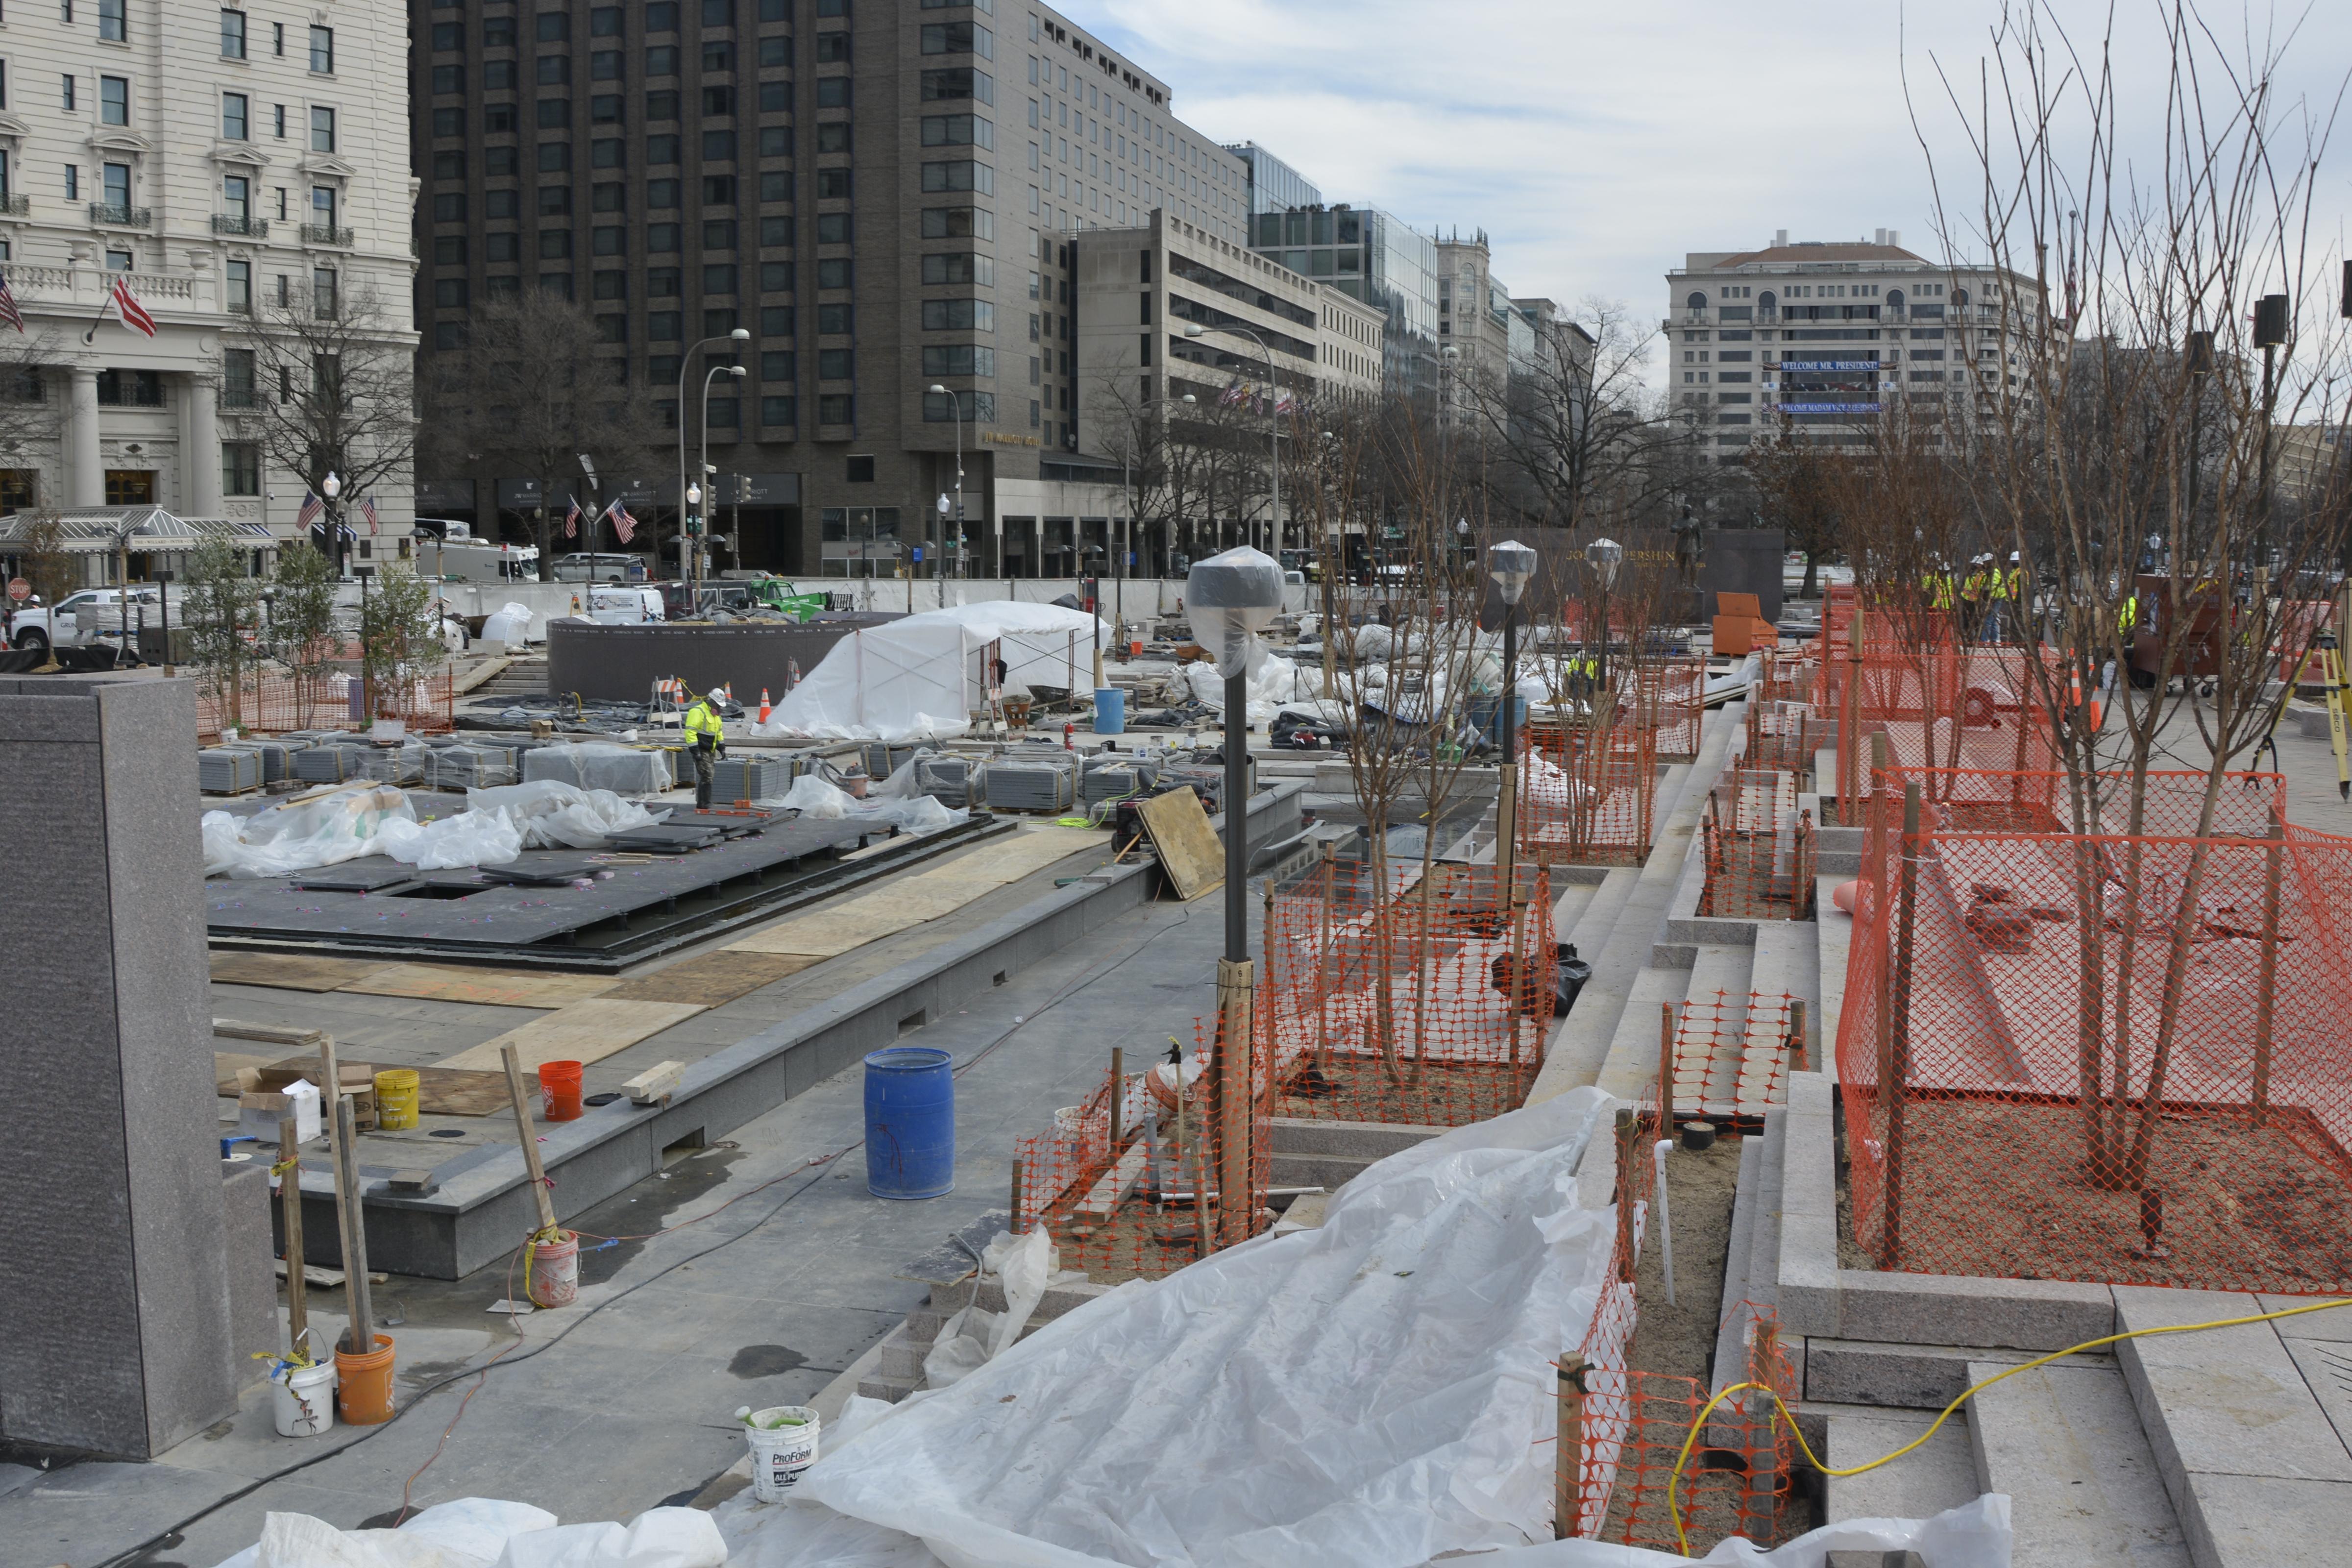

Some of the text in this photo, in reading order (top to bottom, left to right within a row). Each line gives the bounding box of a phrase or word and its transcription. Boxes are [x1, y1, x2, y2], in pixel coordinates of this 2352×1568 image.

[1782, 362, 1818, 370] WELCOME
[1820, 362, 1834, 370] MR.
[1623, 551, 1675, 561] PERSHIN
[10, 585, 29, 594] STOP
